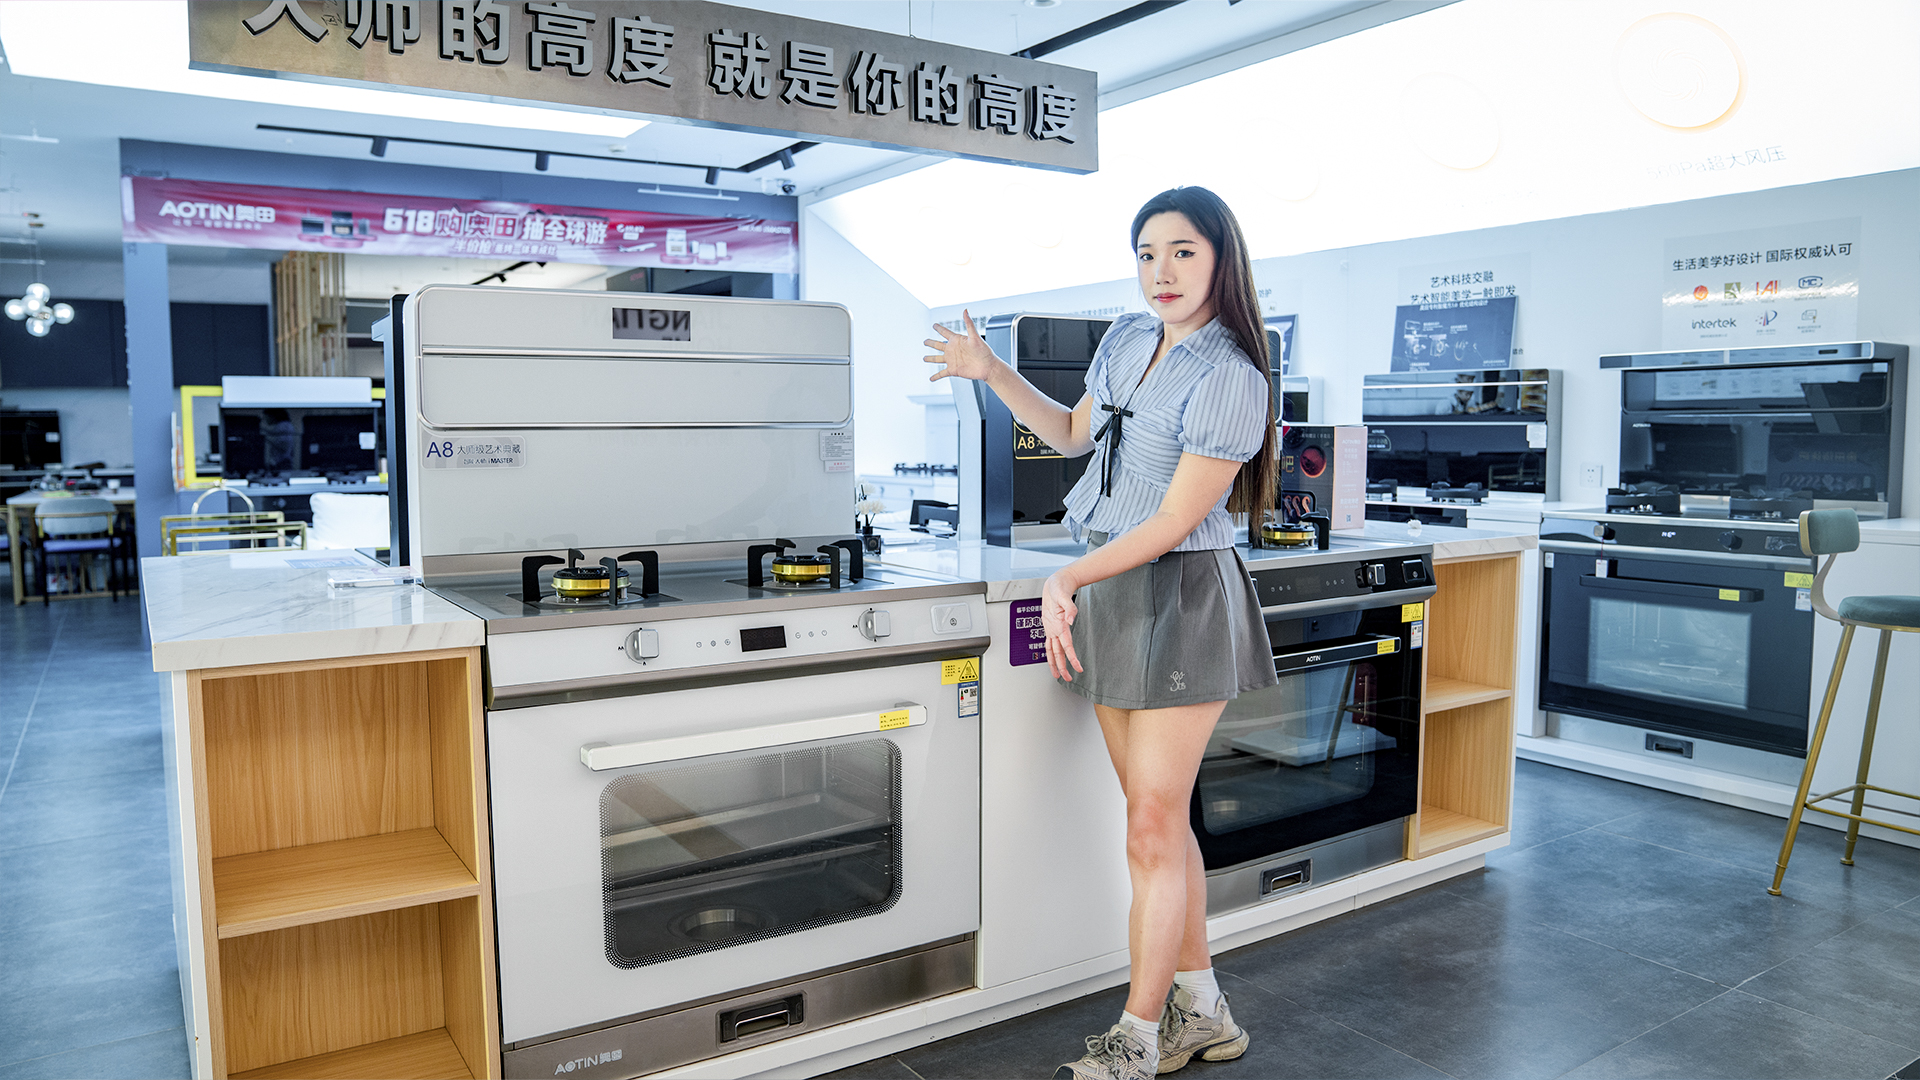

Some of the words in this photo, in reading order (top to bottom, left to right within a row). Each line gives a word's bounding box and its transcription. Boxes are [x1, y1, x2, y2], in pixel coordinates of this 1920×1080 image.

[707, 28, 1077, 145] 就是你的高度
[521, 216, 609, 245] 抽全球游
[1672, 251, 1762, 272] 生活美学好设计
[1766, 242, 1853, 263] 国际权威认可
[1430, 270, 1494, 288] 艺术科技交融
[1691, 317, 1737, 330] intertek
[426, 441, 454, 458] A8
[457, 444, 521, 455] 大师级艺术典藏
[1017, 436, 1035, 450] A8
[1306, 654, 1321, 663] AOTIN
